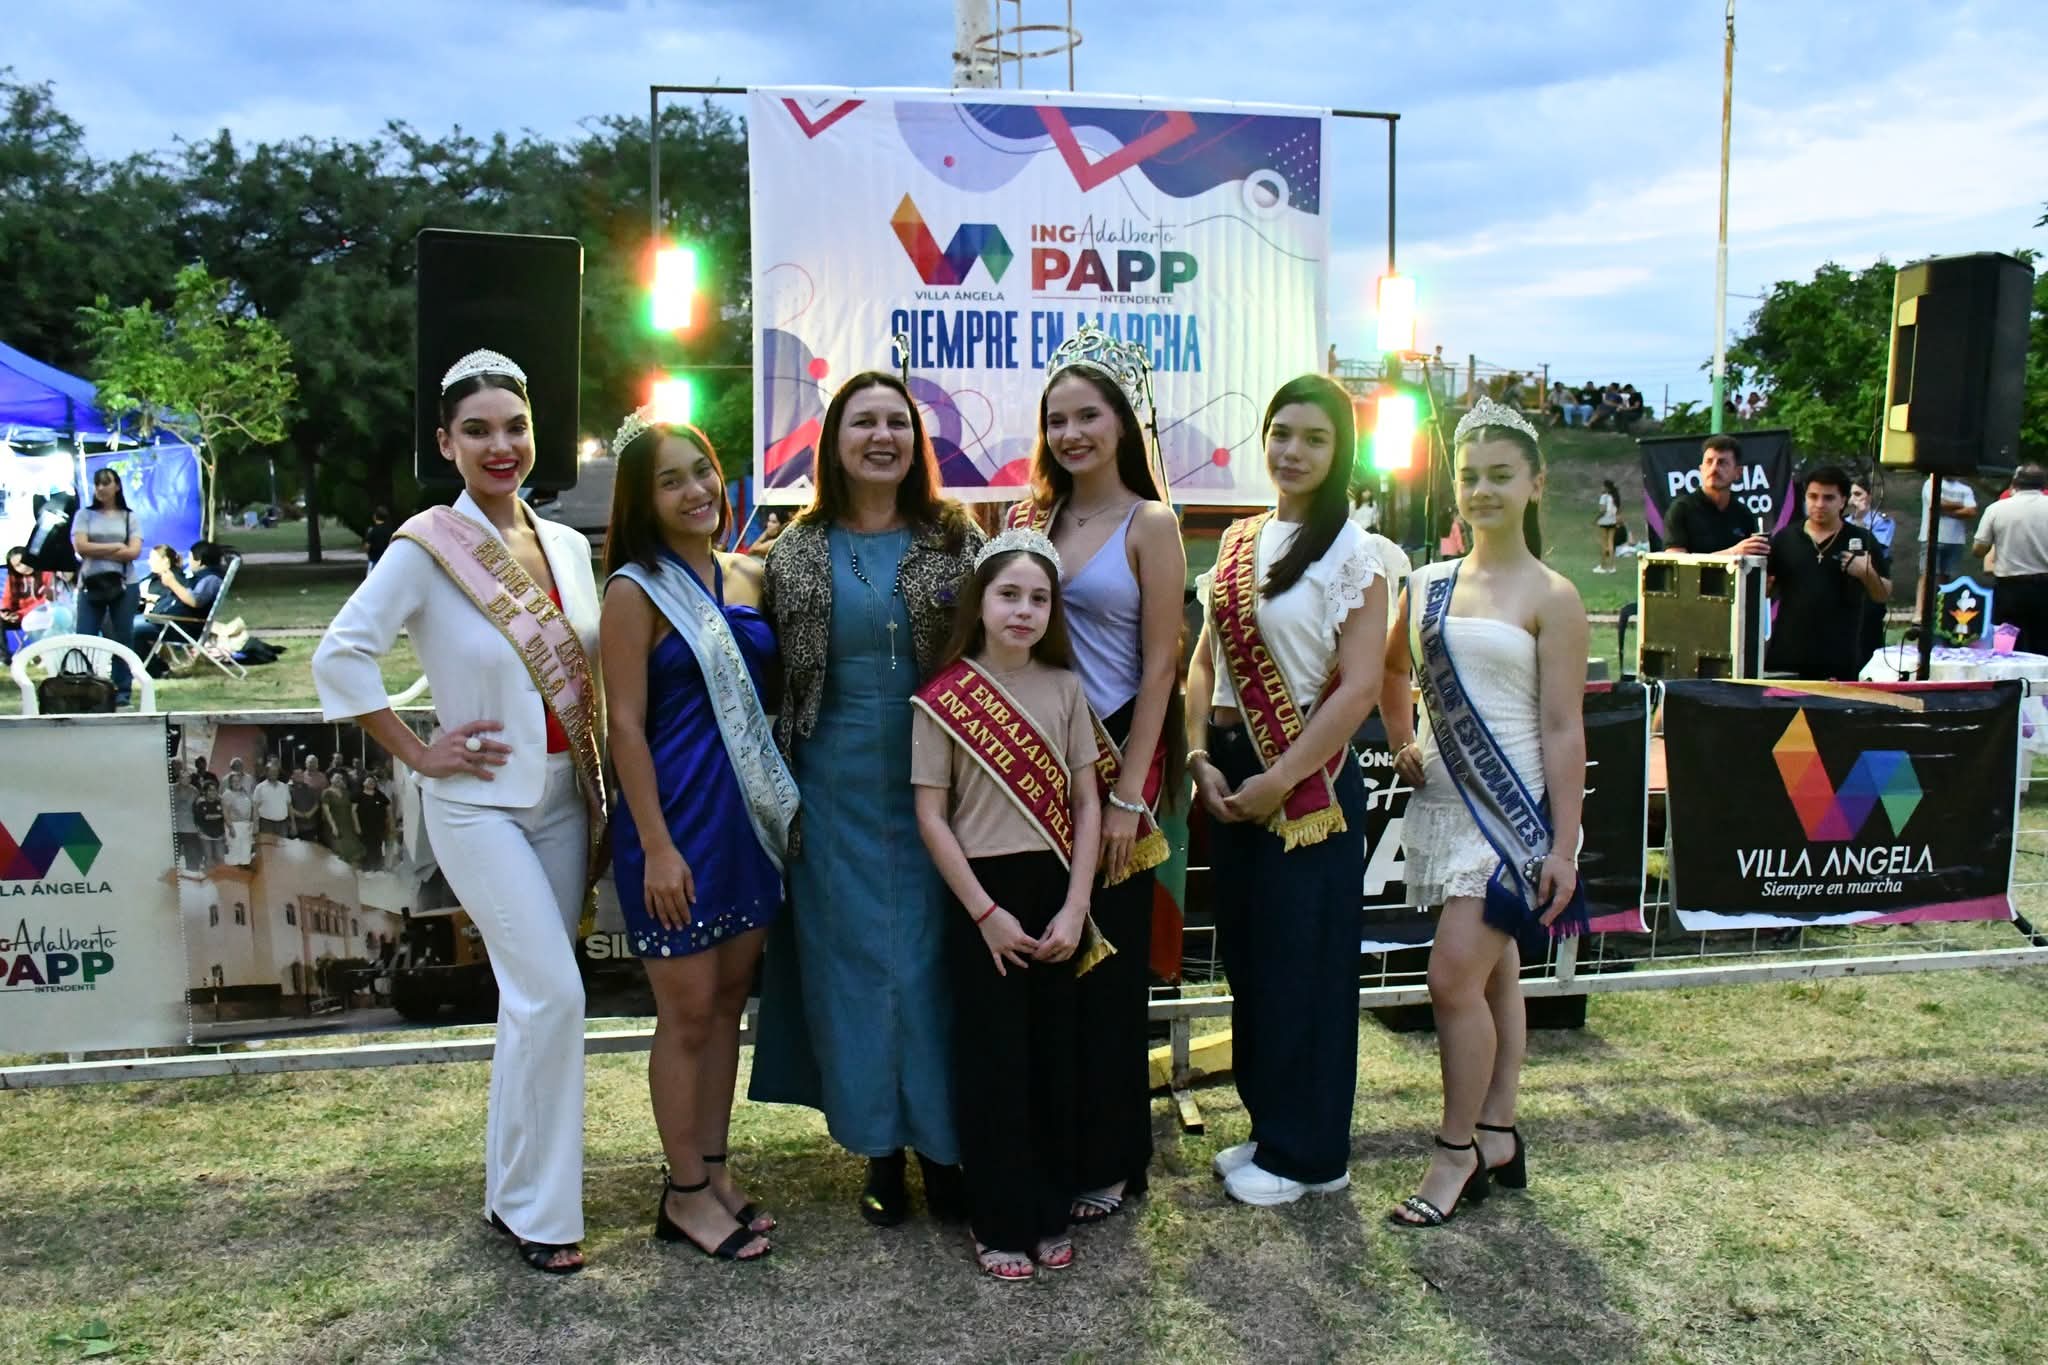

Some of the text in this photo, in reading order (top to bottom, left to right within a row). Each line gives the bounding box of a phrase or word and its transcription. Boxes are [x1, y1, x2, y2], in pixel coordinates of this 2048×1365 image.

[1031, 213, 1177, 249] ING Adalberto
[1031, 248, 1198, 293] PAPP
[914, 291, 950, 301] VILLA
[1100, 295, 1174, 305] INTENDENTE
[892, 309, 1018, 368] SIEMPRE
[1031, 311, 1063, 369] EN
[1668, 464, 1770, 497] POIA
[1251, 645, 1303, 745] CULTUR
[937, 689, 1017, 774] INFANTIL
[1017, 772, 1044, 804] DE
[955, 671, 1066, 806] 1 EMBAJADORA
[1453, 714, 1545, 848] ESTUDIANTES
[1737, 843, 1934, 879] VILLA ANGELA
[31, 880, 113, 896] ÁNGELA
[1761, 876, 1903, 900] Siempre en marcha
[11, 918, 118, 955] Adalberto
[34, 984, 96, 993] INTENDENTE
